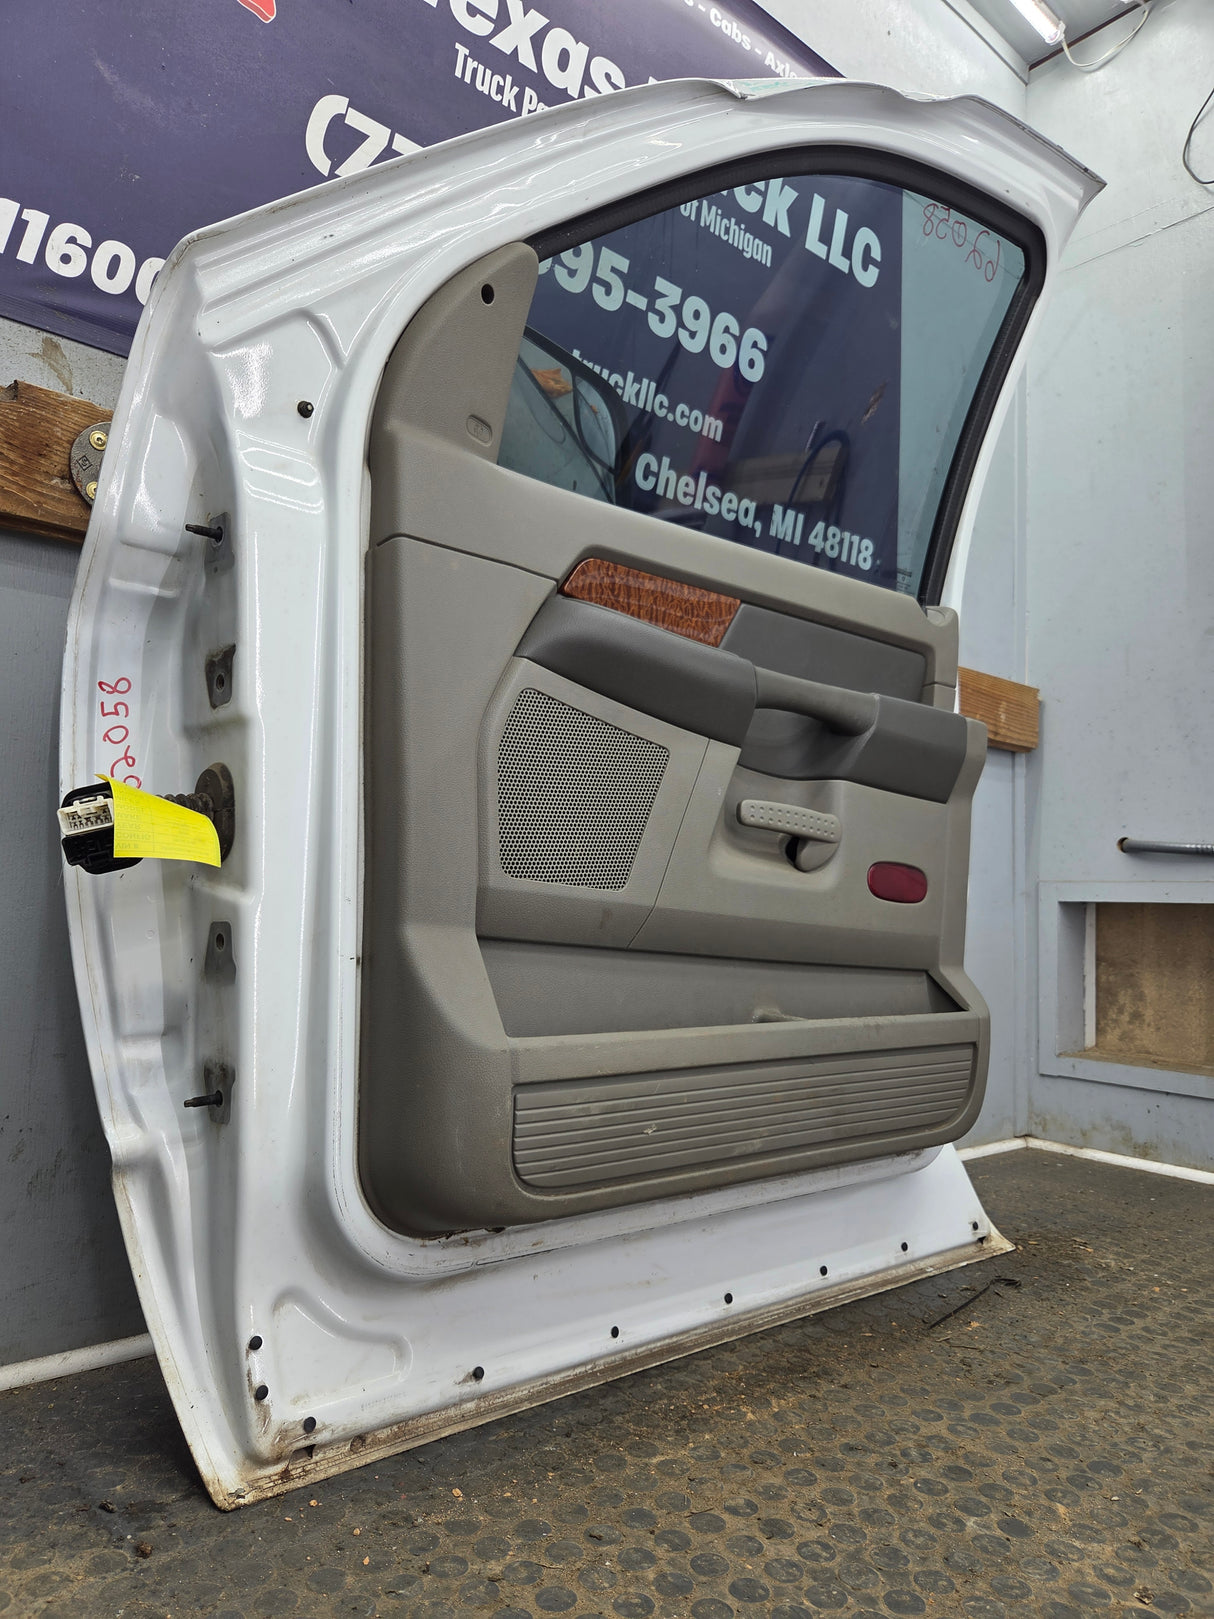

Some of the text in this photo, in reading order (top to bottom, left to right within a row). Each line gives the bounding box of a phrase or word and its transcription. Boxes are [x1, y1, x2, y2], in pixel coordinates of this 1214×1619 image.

[709, 8, 751, 50] Cabs
[427, 0, 626, 98] exas
[805, 193, 882, 288] LLC
[454, 42, 519, 112] Truck
[700, 199, 772, 268] Michigan
[538, 240, 768, 383] 95-3966
[634, 452, 875, 571] Chelsea, MI 48118
